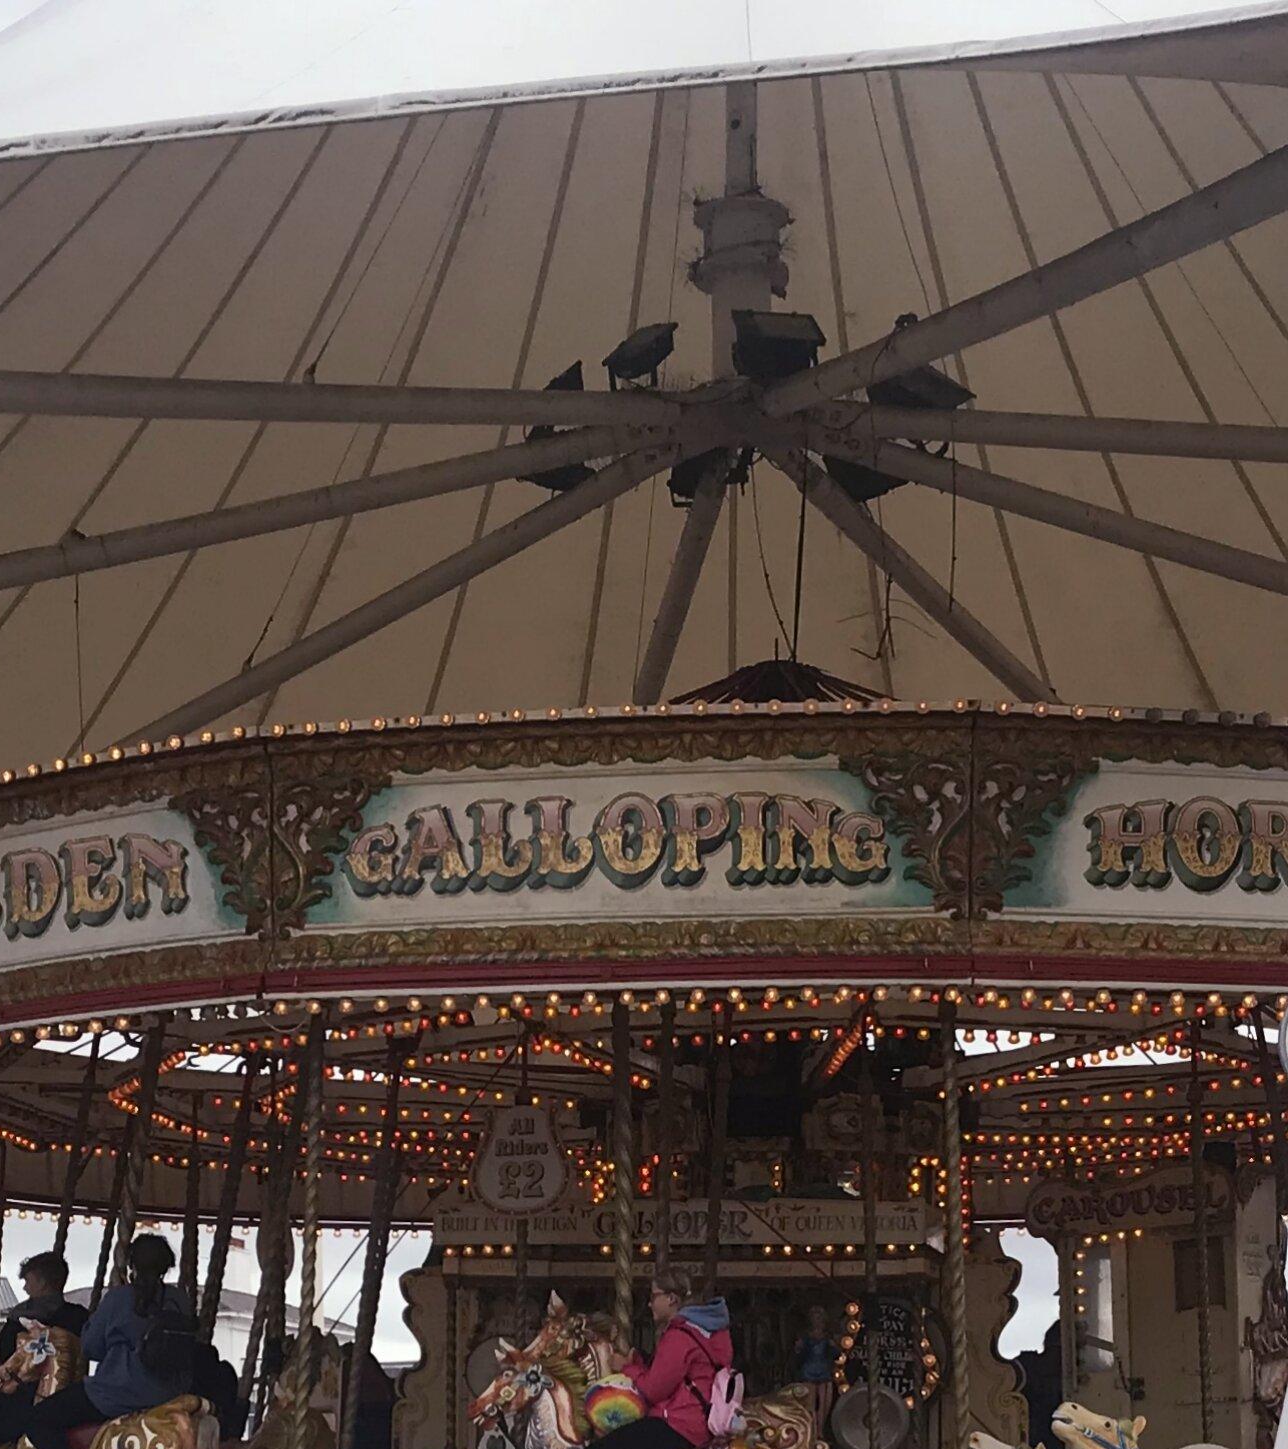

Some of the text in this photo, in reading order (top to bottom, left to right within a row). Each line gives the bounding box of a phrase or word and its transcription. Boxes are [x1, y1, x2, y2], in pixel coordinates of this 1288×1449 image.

[341, 792, 892, 898] GALLOPING
[508, 1117, 536, 1136] All
[494, 1140, 550, 1157] Riders
[497, 1161, 545, 1200] £2
